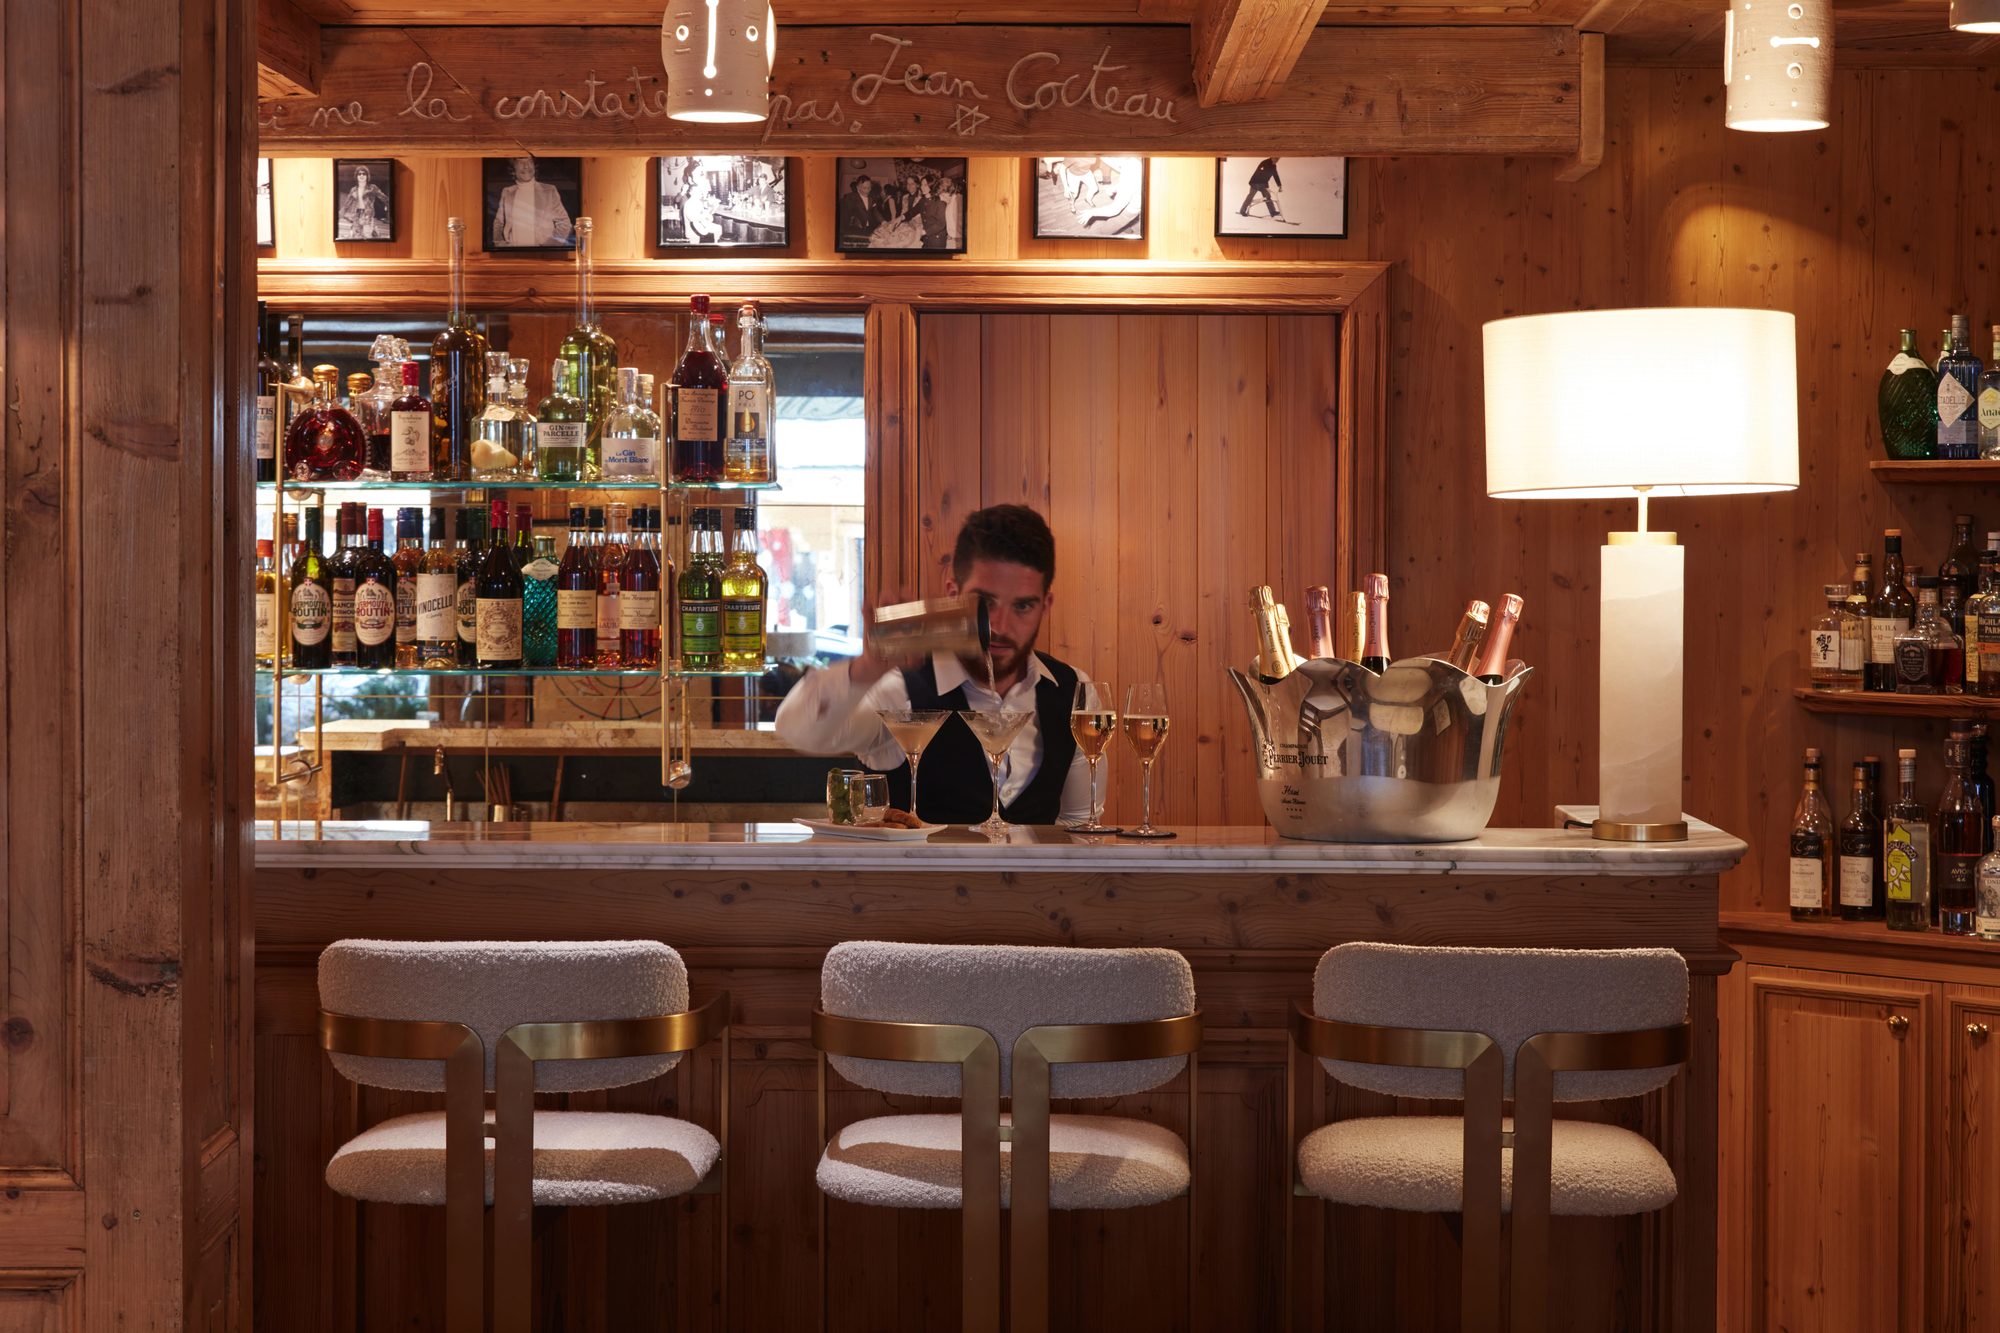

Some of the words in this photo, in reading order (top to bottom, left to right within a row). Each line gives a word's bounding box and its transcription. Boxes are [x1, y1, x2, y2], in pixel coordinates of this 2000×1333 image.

[852, 33, 988, 105] Jean
[1006, 45, 1177, 124] Cocteau
[309, 101, 379, 127] ne
[398, 62, 472, 121] la
[494, 66, 668, 119] constate
[358, 600, 389, 608] VERMOUTH
[418, 594, 453, 615] VINOCELLO
[293, 607, 327, 617] ROUTIN
[356, 607, 390, 617] ROUTIN
